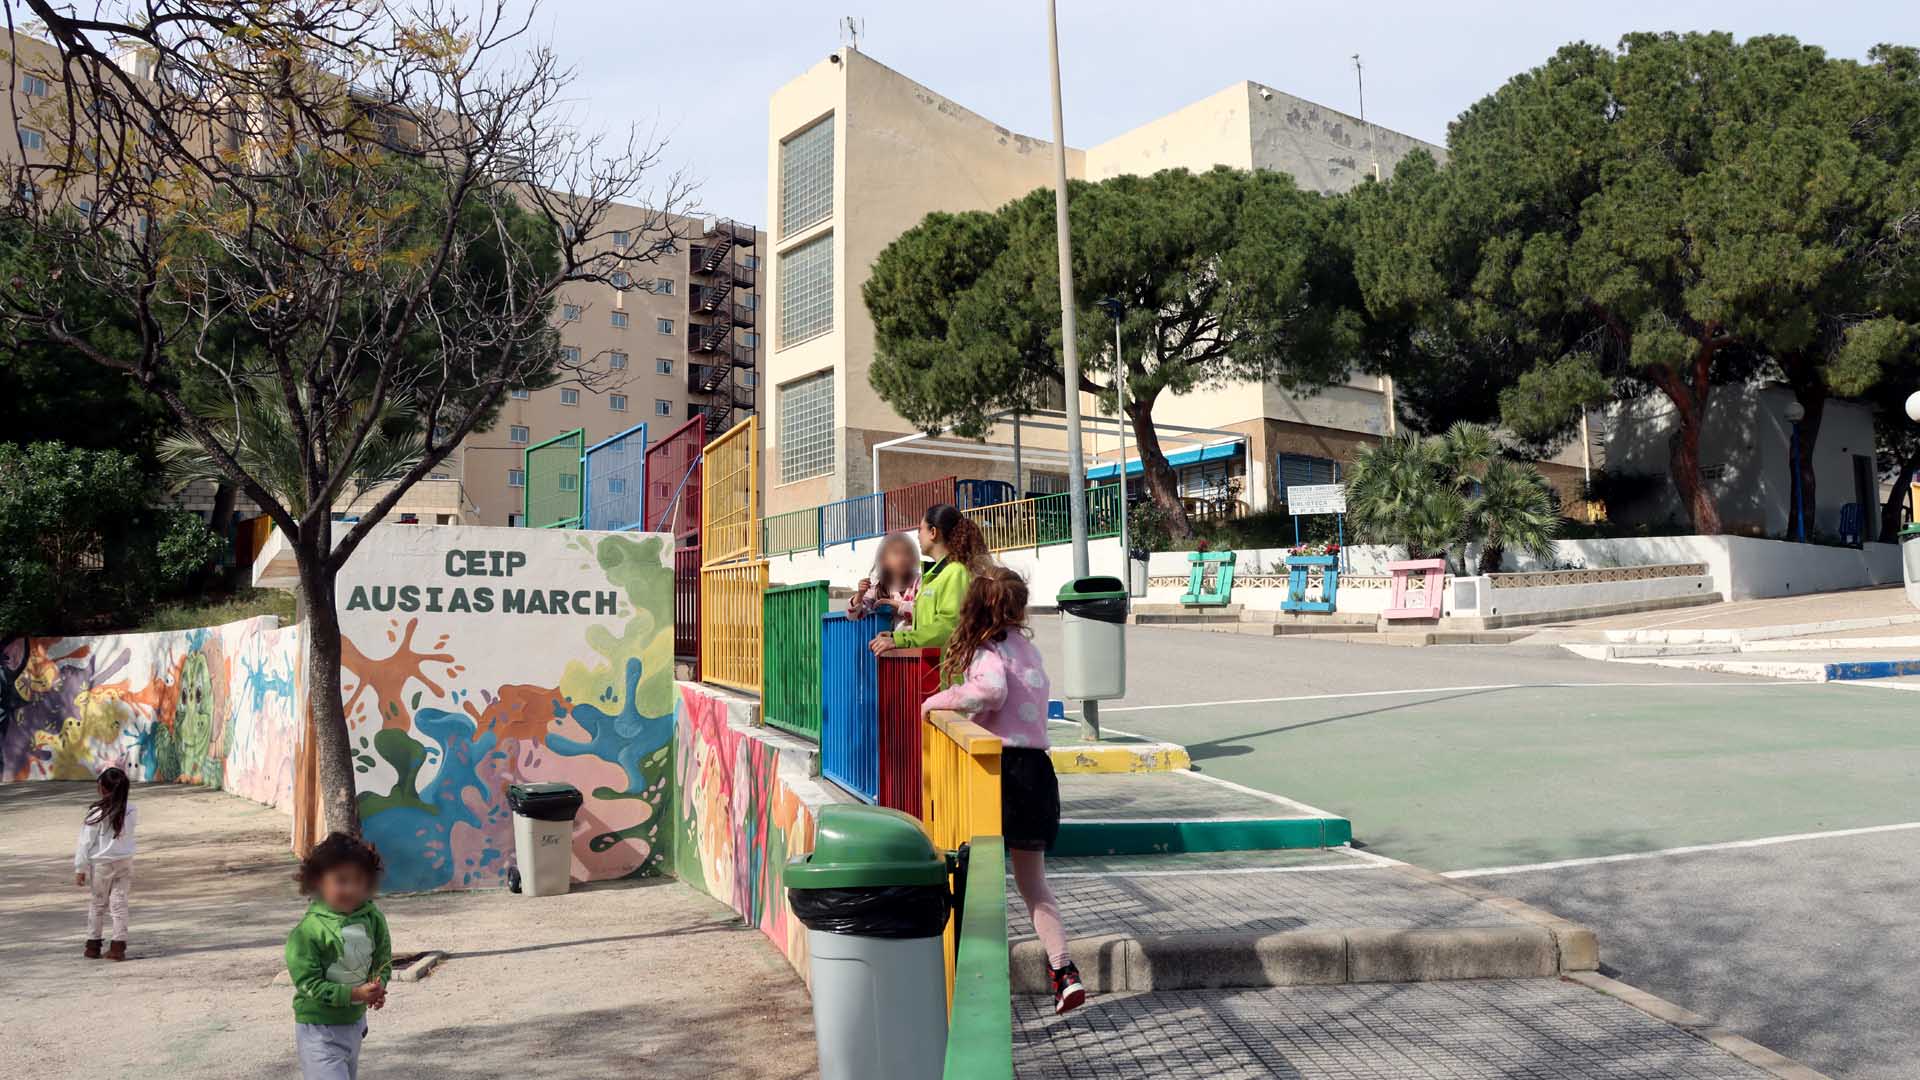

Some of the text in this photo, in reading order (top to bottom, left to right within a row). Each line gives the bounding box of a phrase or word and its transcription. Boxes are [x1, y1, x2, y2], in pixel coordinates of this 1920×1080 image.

[445, 549, 526, 577] CEIP
[346, 585, 617, 615] AUSIAS MARCH
